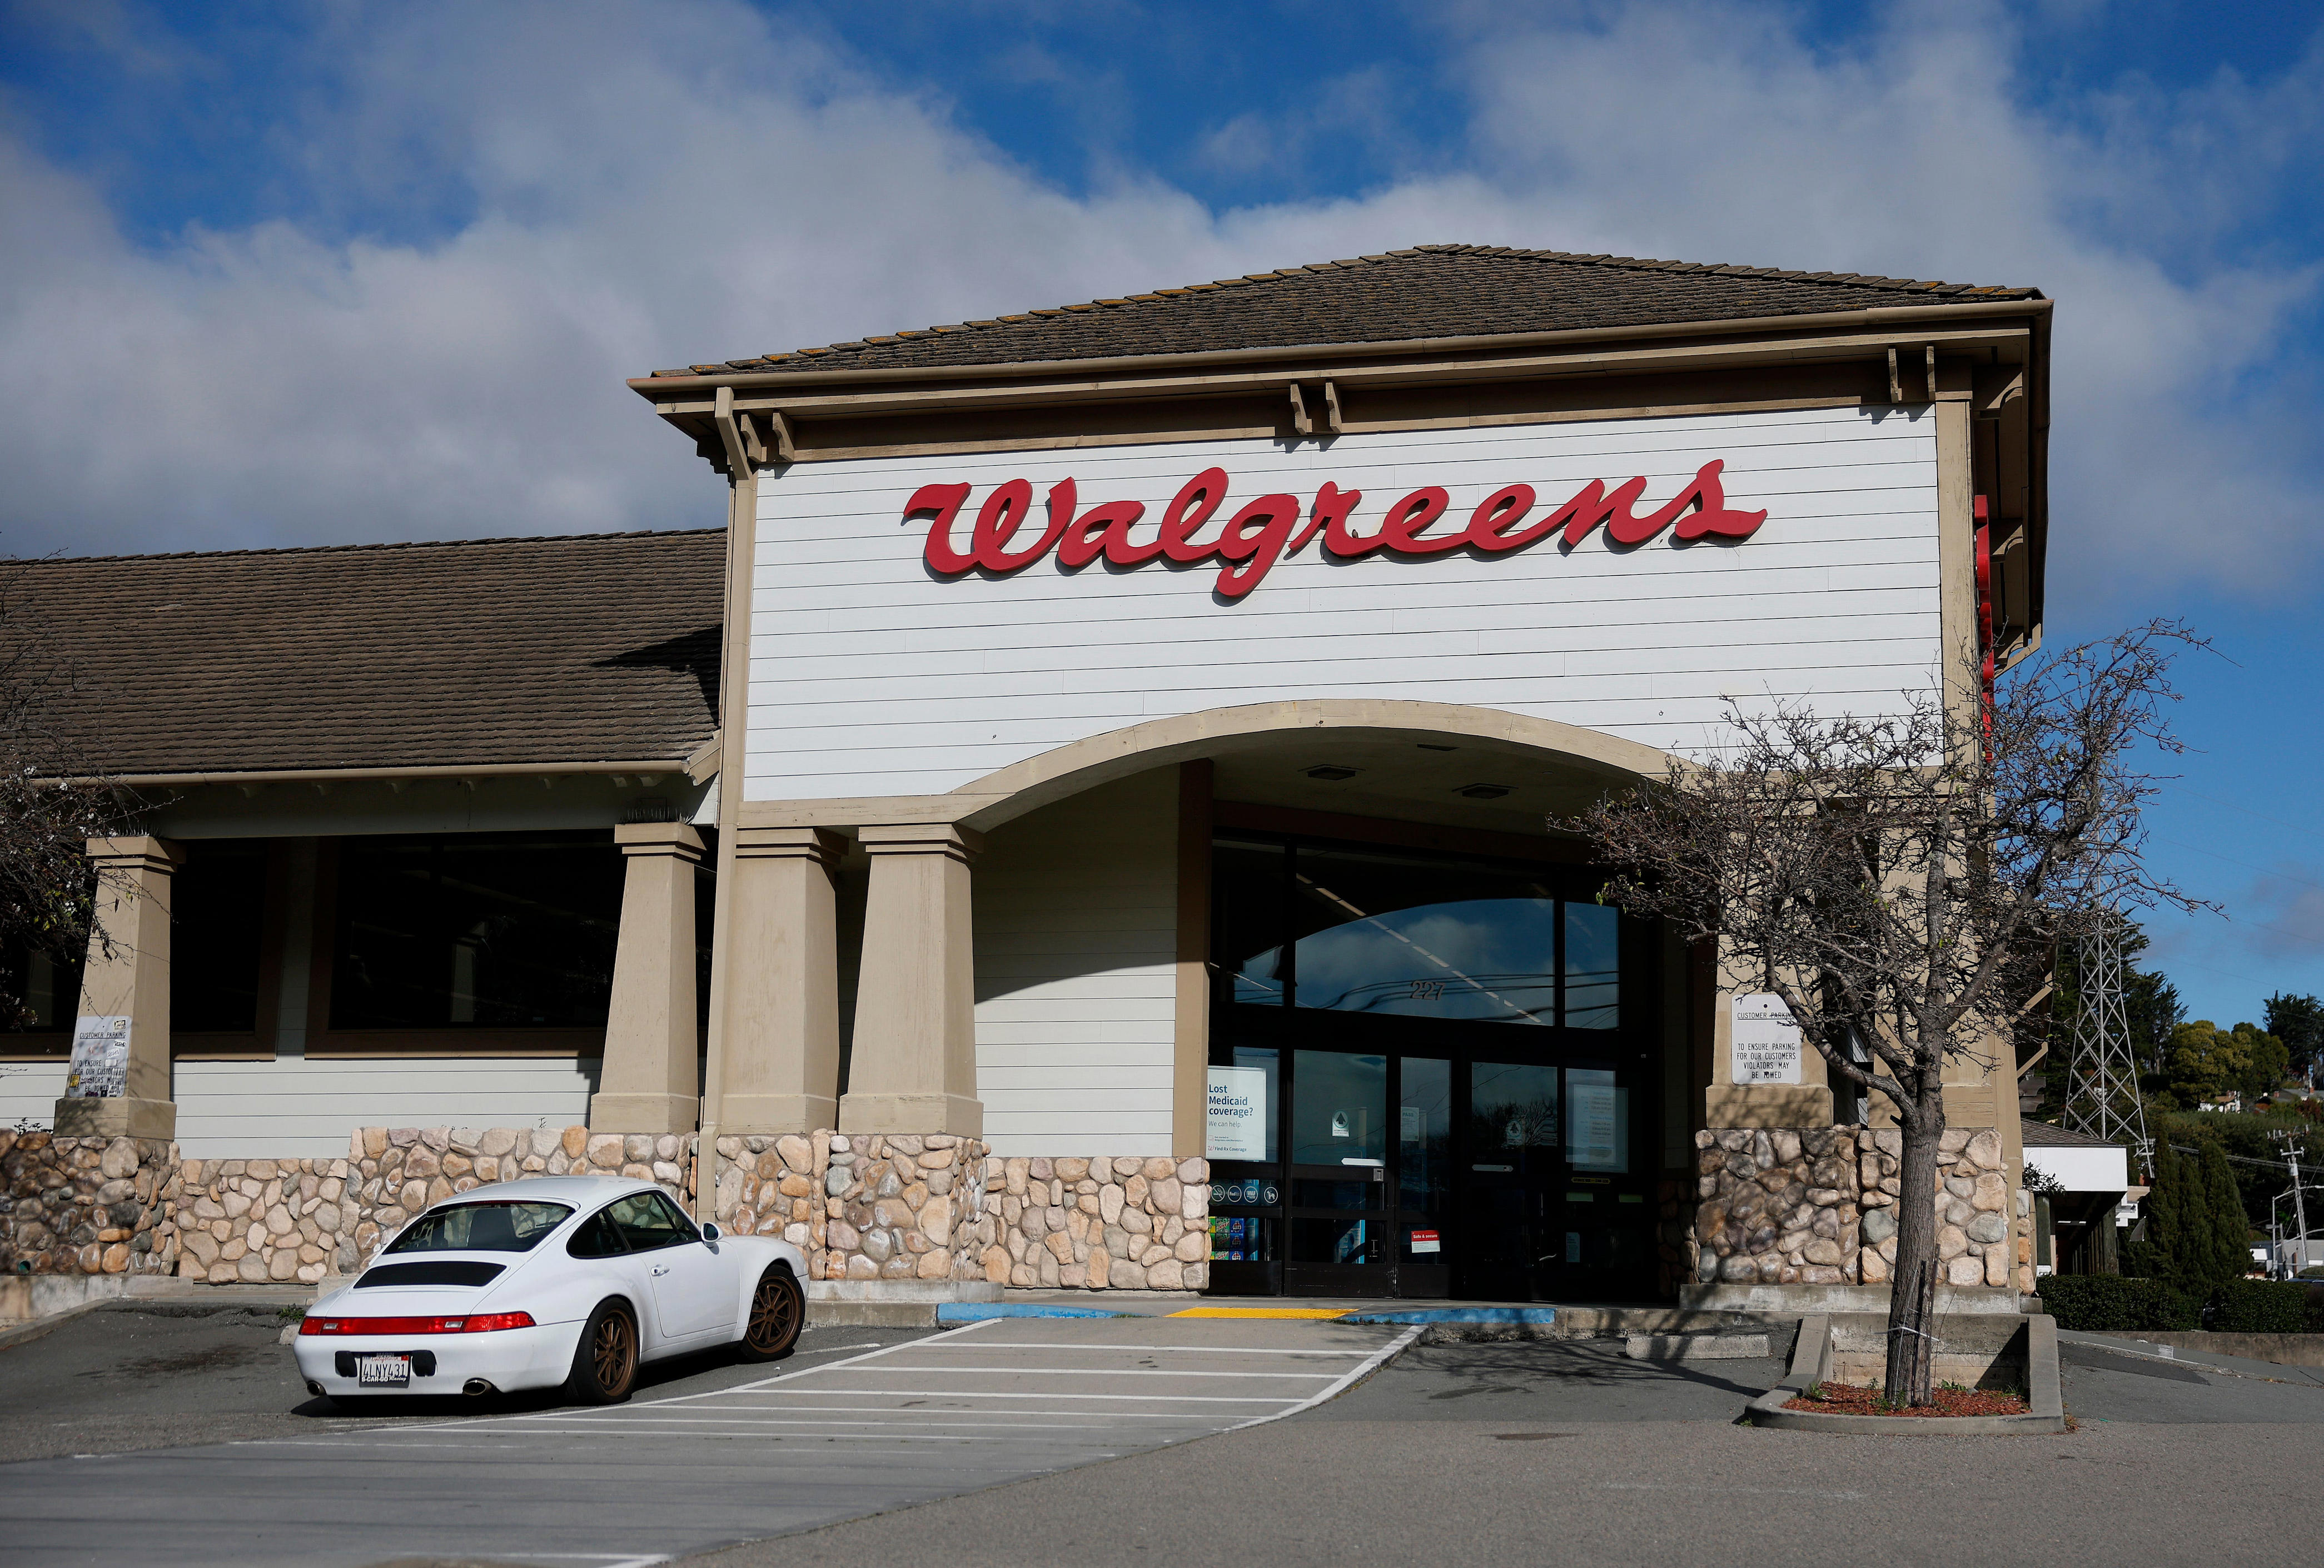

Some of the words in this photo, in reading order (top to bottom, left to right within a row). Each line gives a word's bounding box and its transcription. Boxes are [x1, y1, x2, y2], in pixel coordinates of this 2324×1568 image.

[904, 460, 1767, 595] Walgreens
[1411, 980, 1446, 1001] 227
[1209, 1084, 1227, 1093] Lost
[1209, 1096, 1248, 1106] Medicaid
[1209, 1107, 1253, 1118] coverage?
[363, 1363, 405, 1377] 4LNY431
